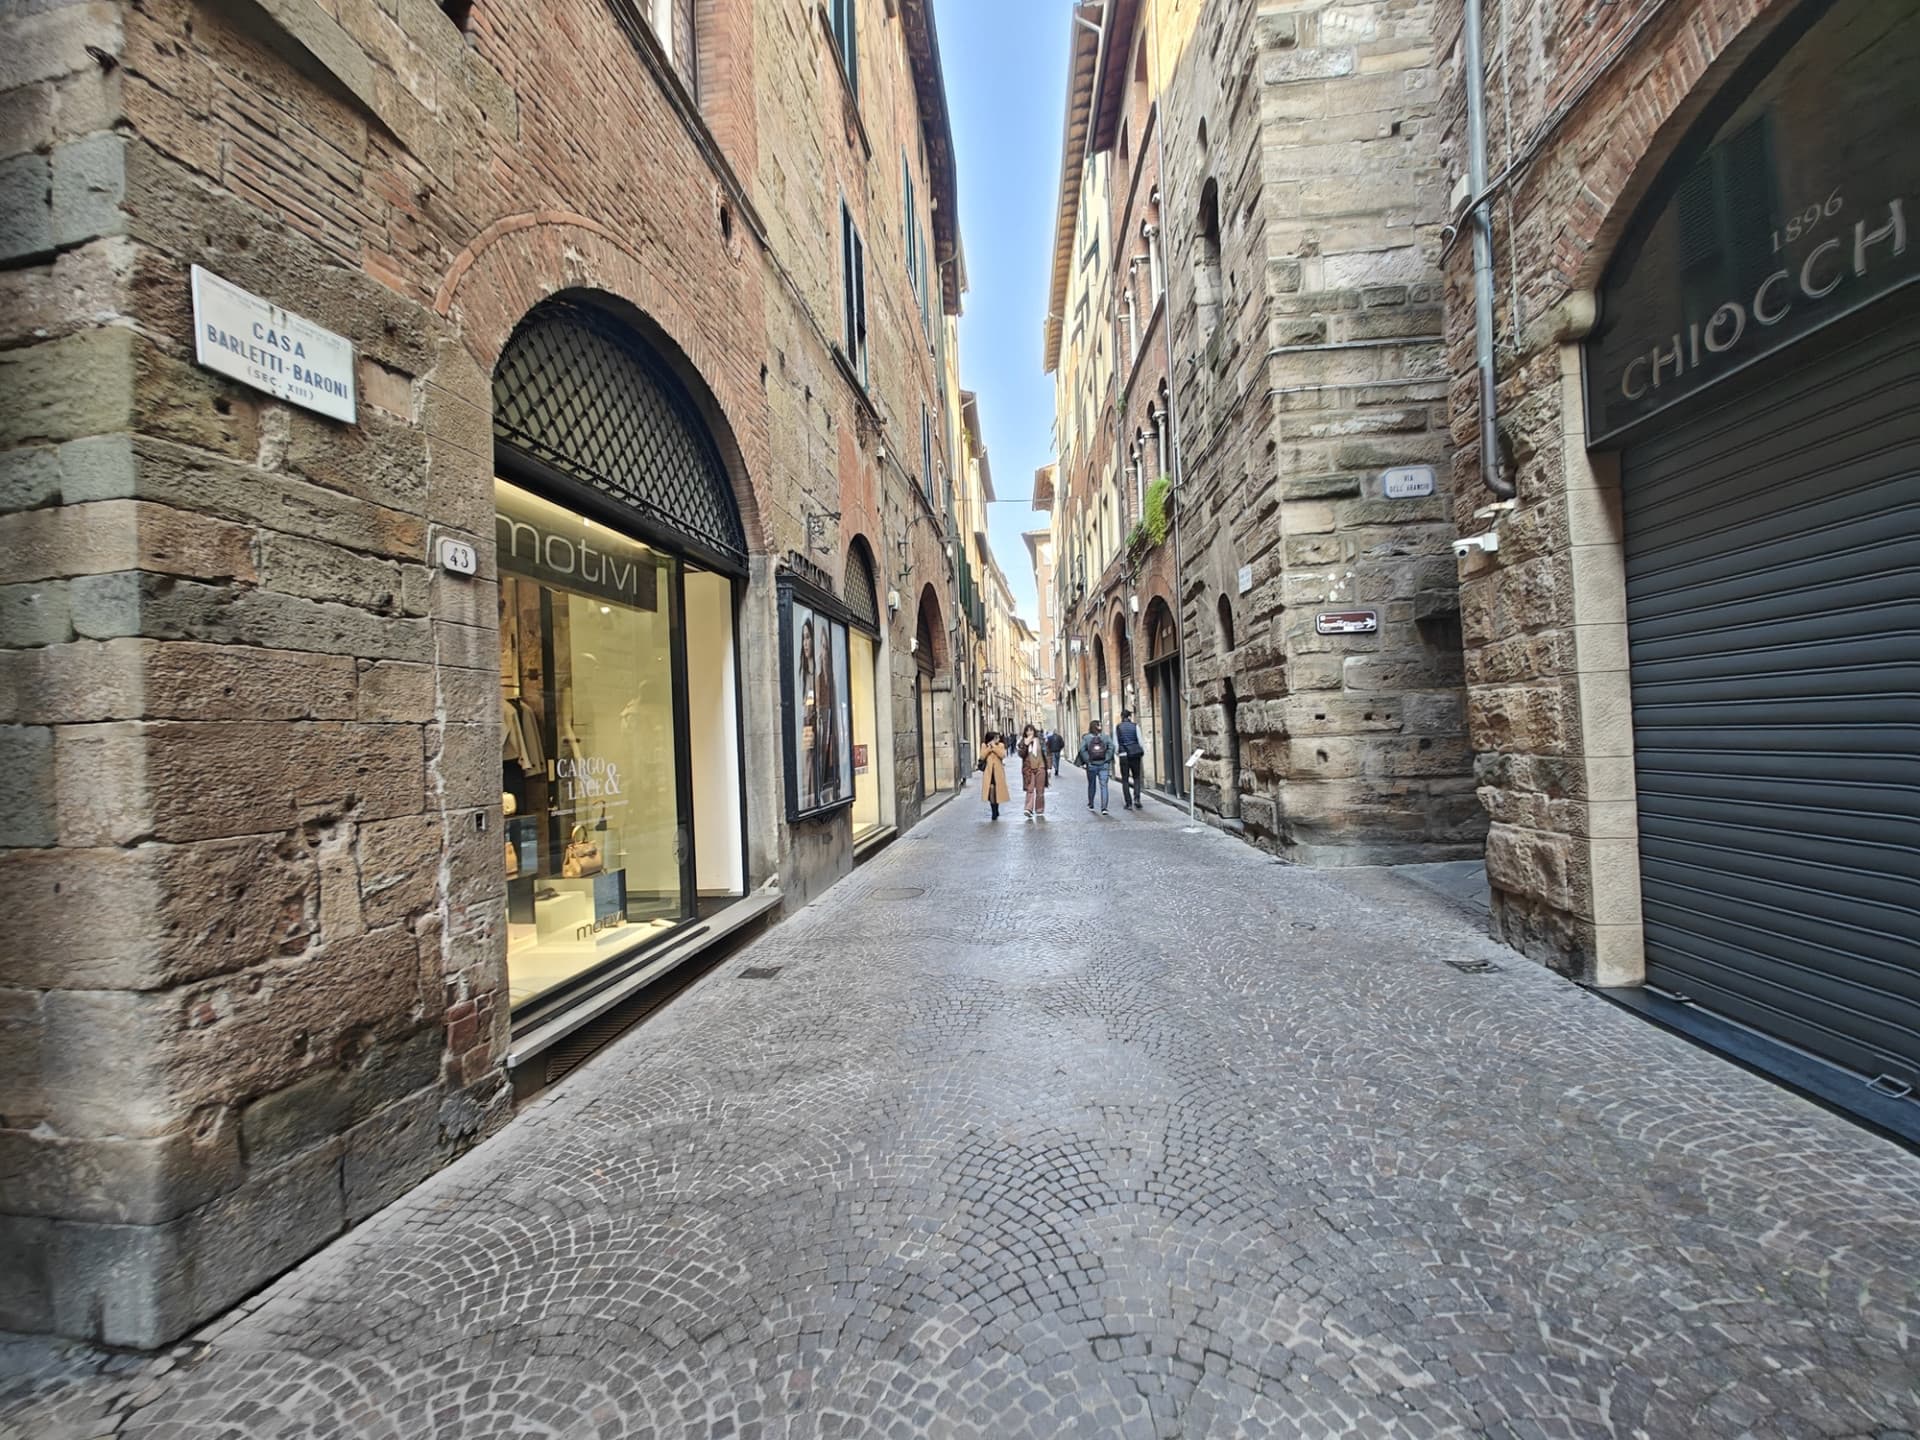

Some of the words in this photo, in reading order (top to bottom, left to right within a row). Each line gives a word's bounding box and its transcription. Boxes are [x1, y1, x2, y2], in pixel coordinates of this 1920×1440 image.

[1771, 186, 1844, 253] 1896
[1621, 198, 1906, 401] CHIOCCH
[253, 321, 306, 360] CASA
[450, 546, 469, 569] 43
[556, 756, 606, 778] CARGO
